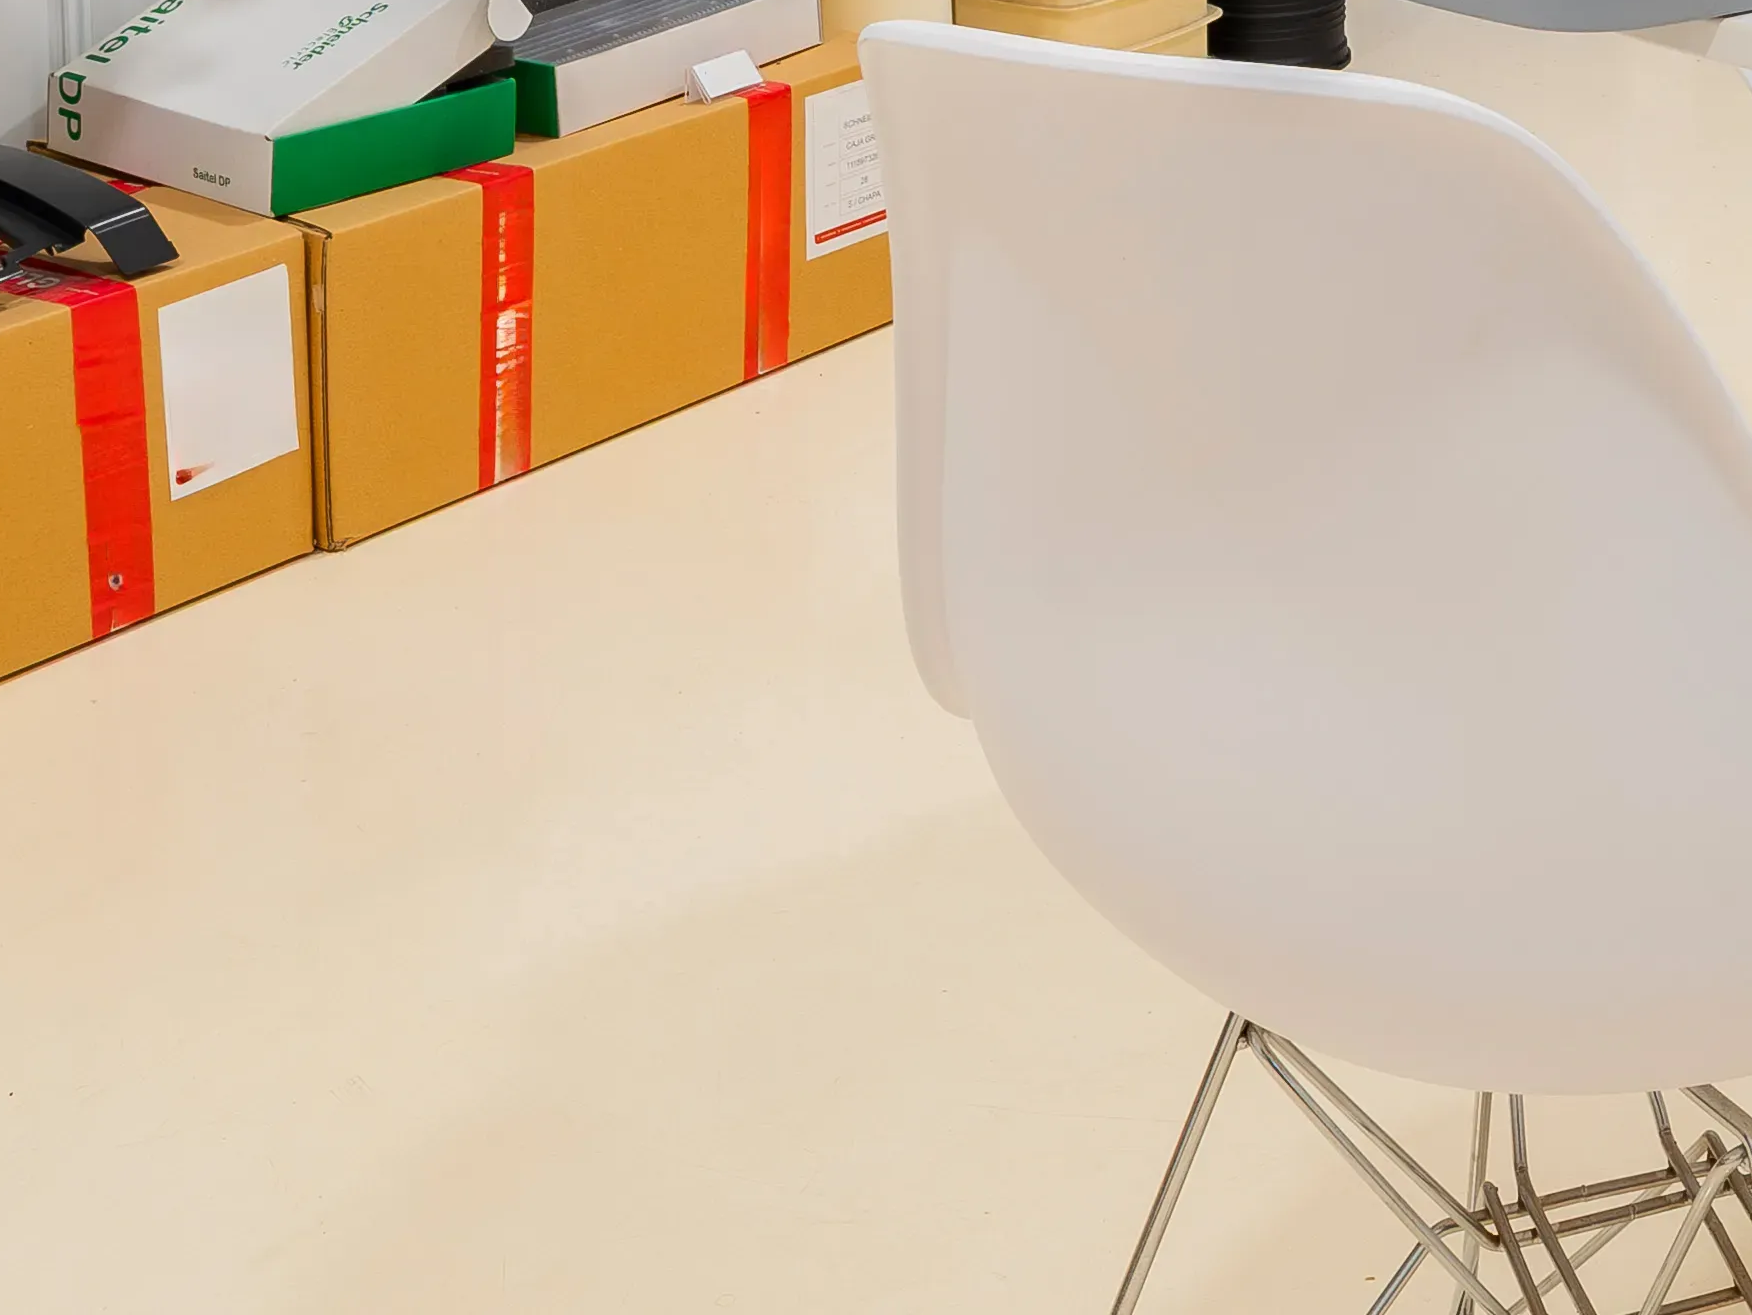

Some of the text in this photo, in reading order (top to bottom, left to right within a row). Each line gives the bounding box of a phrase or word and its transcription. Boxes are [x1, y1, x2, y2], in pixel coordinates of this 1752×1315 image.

[292, 2, 390, 71] Schneider
[57, 71, 88, 142] DP
[193, 167, 232, 187] Saitel DP
